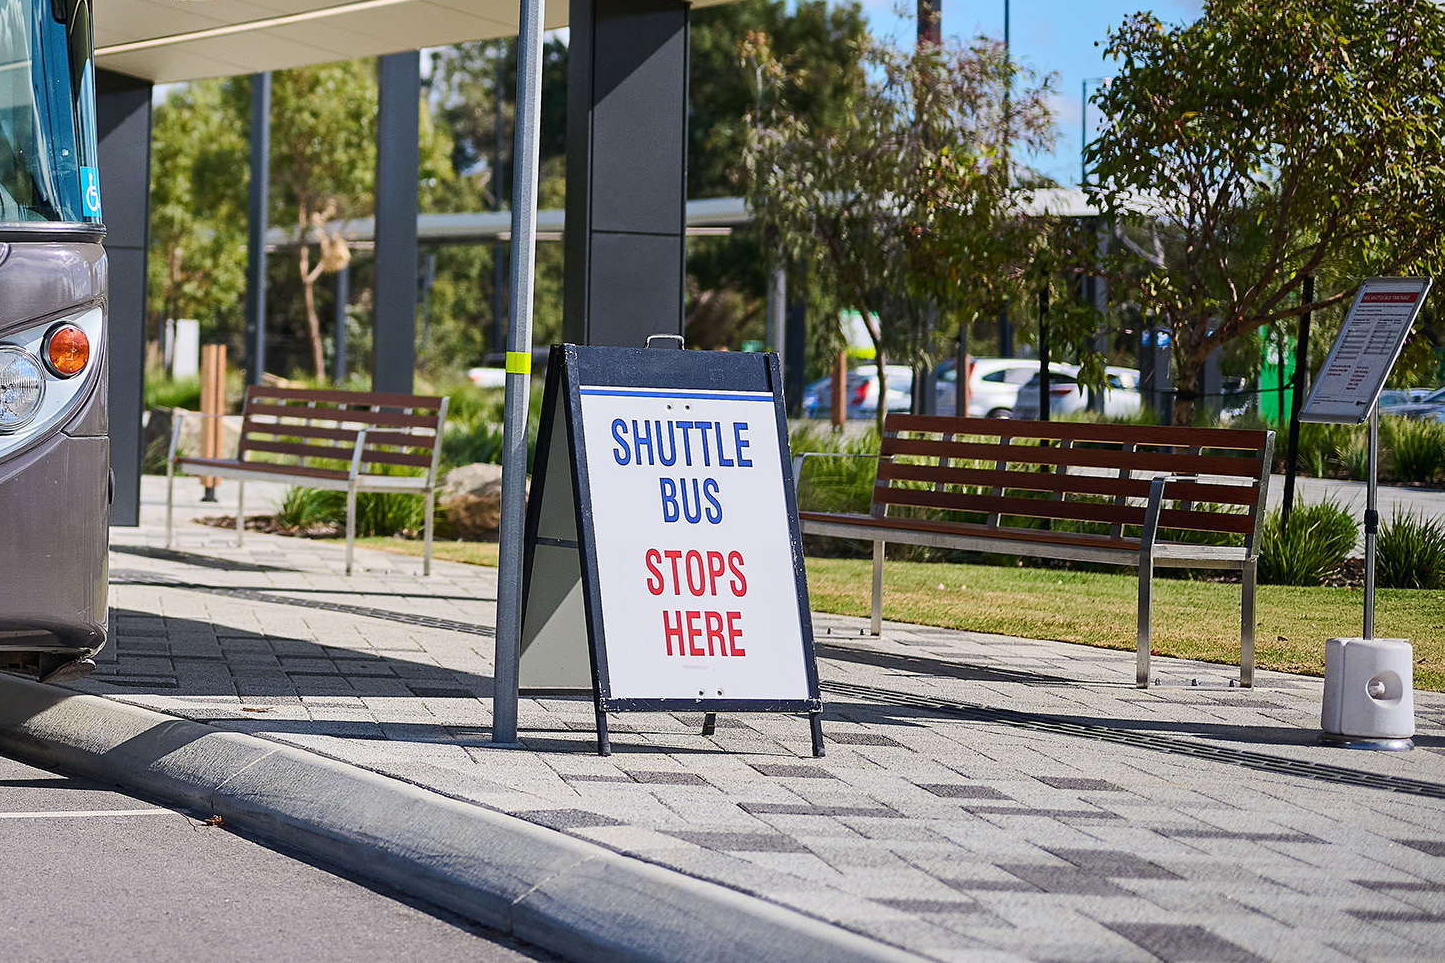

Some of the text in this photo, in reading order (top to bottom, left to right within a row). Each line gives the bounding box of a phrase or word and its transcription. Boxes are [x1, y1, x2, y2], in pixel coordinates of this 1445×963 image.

[611, 417, 754, 468] SHUTTLE
[659, 477, 724, 525] BUS
[645, 548, 748, 598] STOPS
[662, 610, 746, 657] HERE
